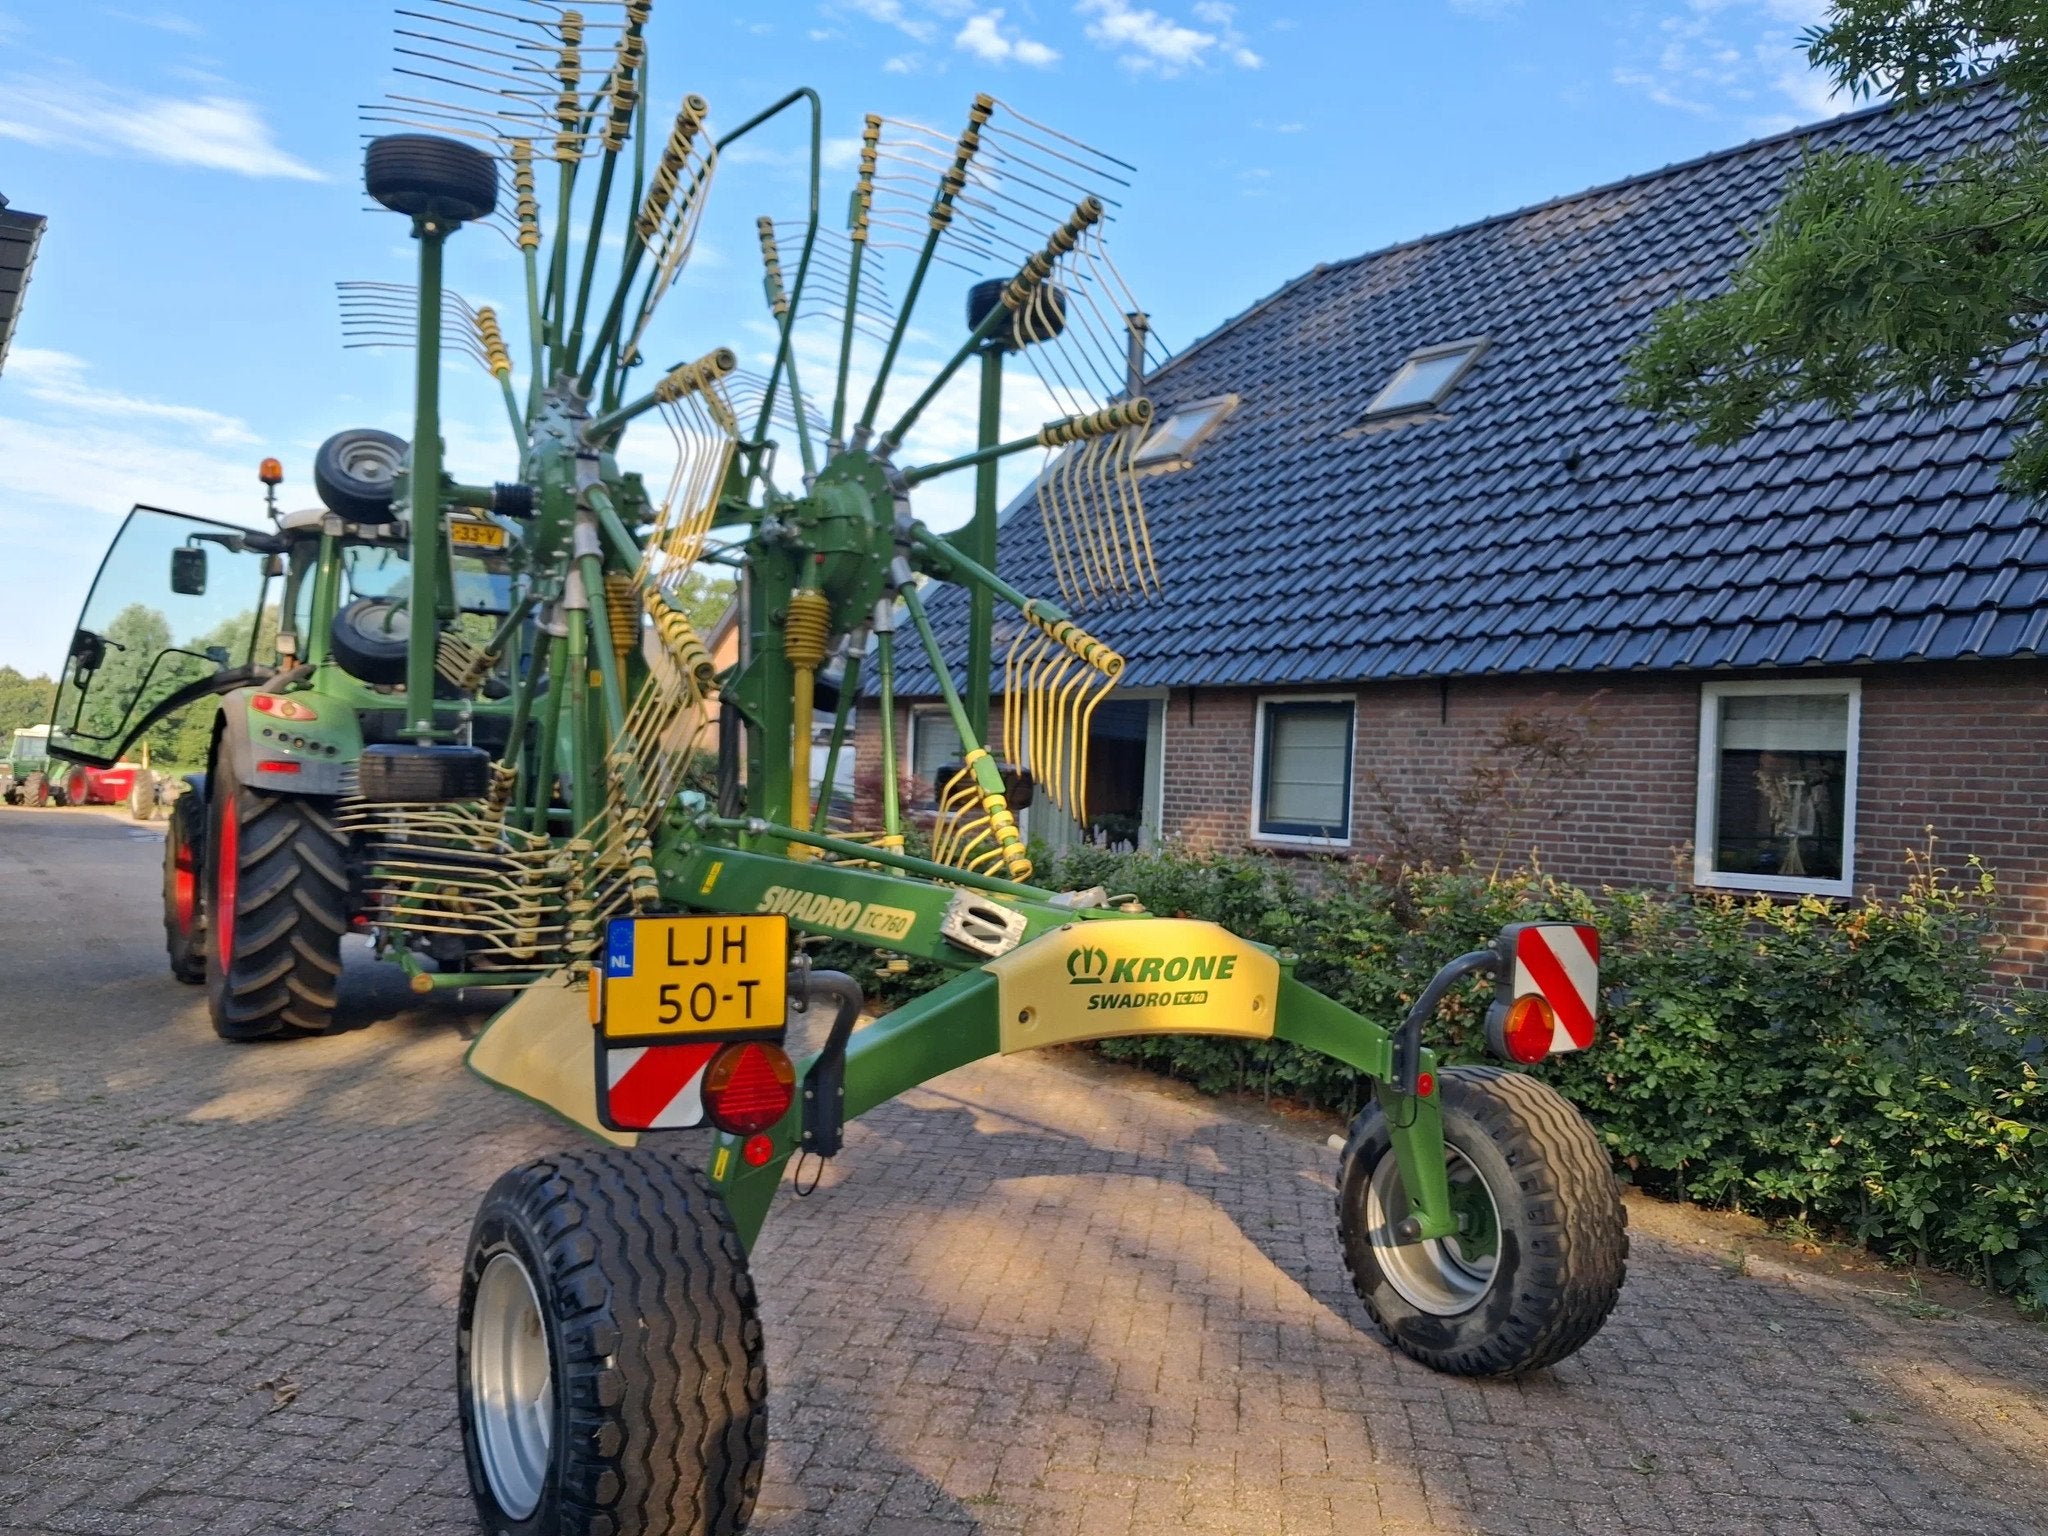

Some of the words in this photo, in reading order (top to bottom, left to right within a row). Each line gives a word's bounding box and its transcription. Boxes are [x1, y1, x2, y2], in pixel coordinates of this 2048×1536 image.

[757, 885, 861, 930] SWADRO
[863, 911, 883, 928] TC
[881, 914, 907, 933] 760
[610, 955, 631, 968] NL
[667, 925, 747, 967] LJH
[1109, 954, 1238, 984] KRONE
[658, 979, 760, 1025] 50-T
[1087, 992, 1171, 1010] SWADRO
[1176, 994, 1189, 1003] TC
[1189, 993, 1206, 1003] 760
